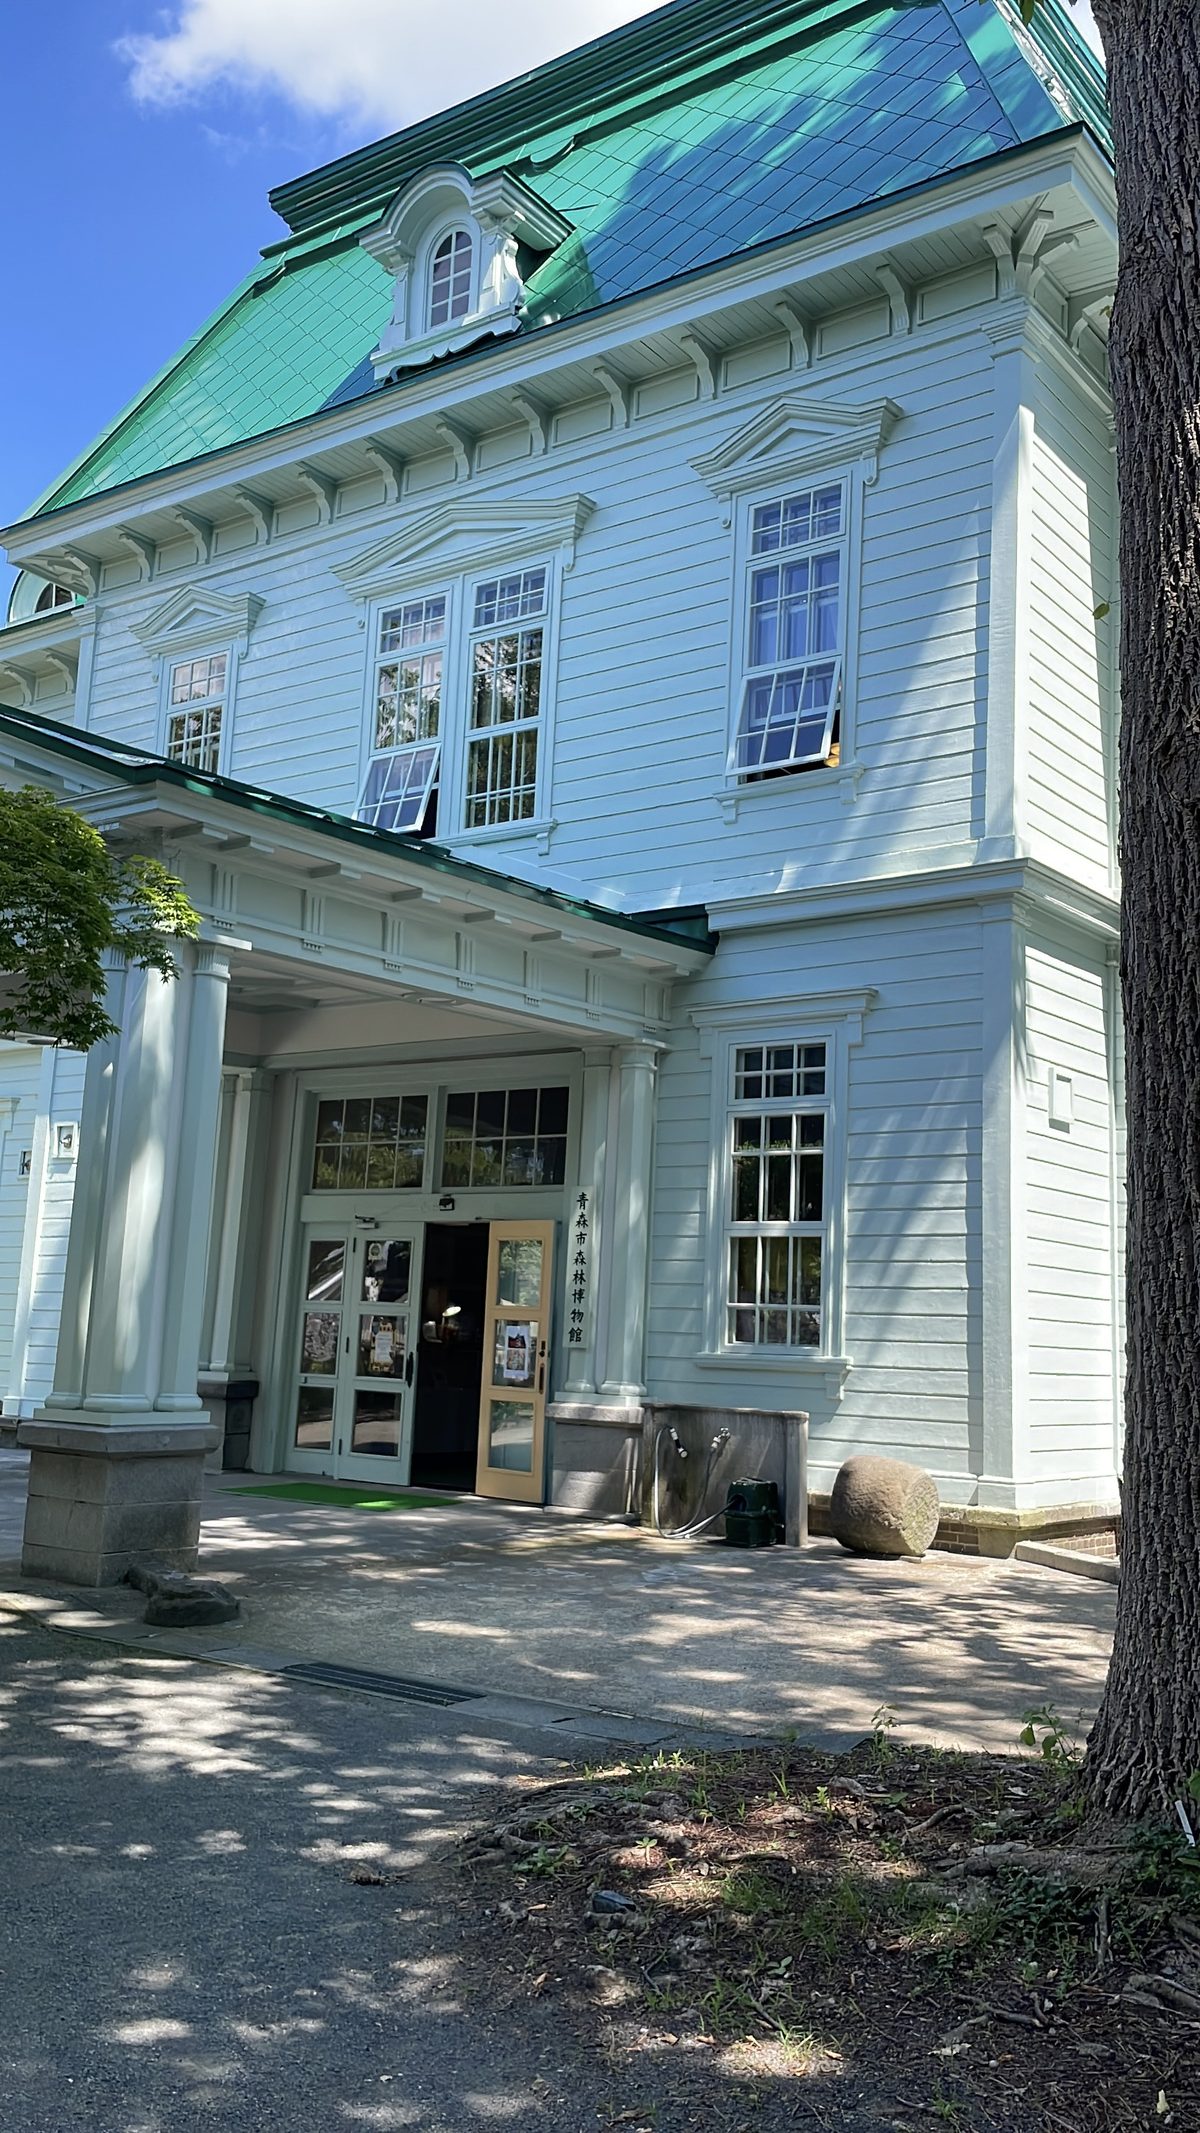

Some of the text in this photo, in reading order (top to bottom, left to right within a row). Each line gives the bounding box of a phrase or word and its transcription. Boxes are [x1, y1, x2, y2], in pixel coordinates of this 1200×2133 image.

[568, 1192, 589, 1343] 青森市森林博物館
